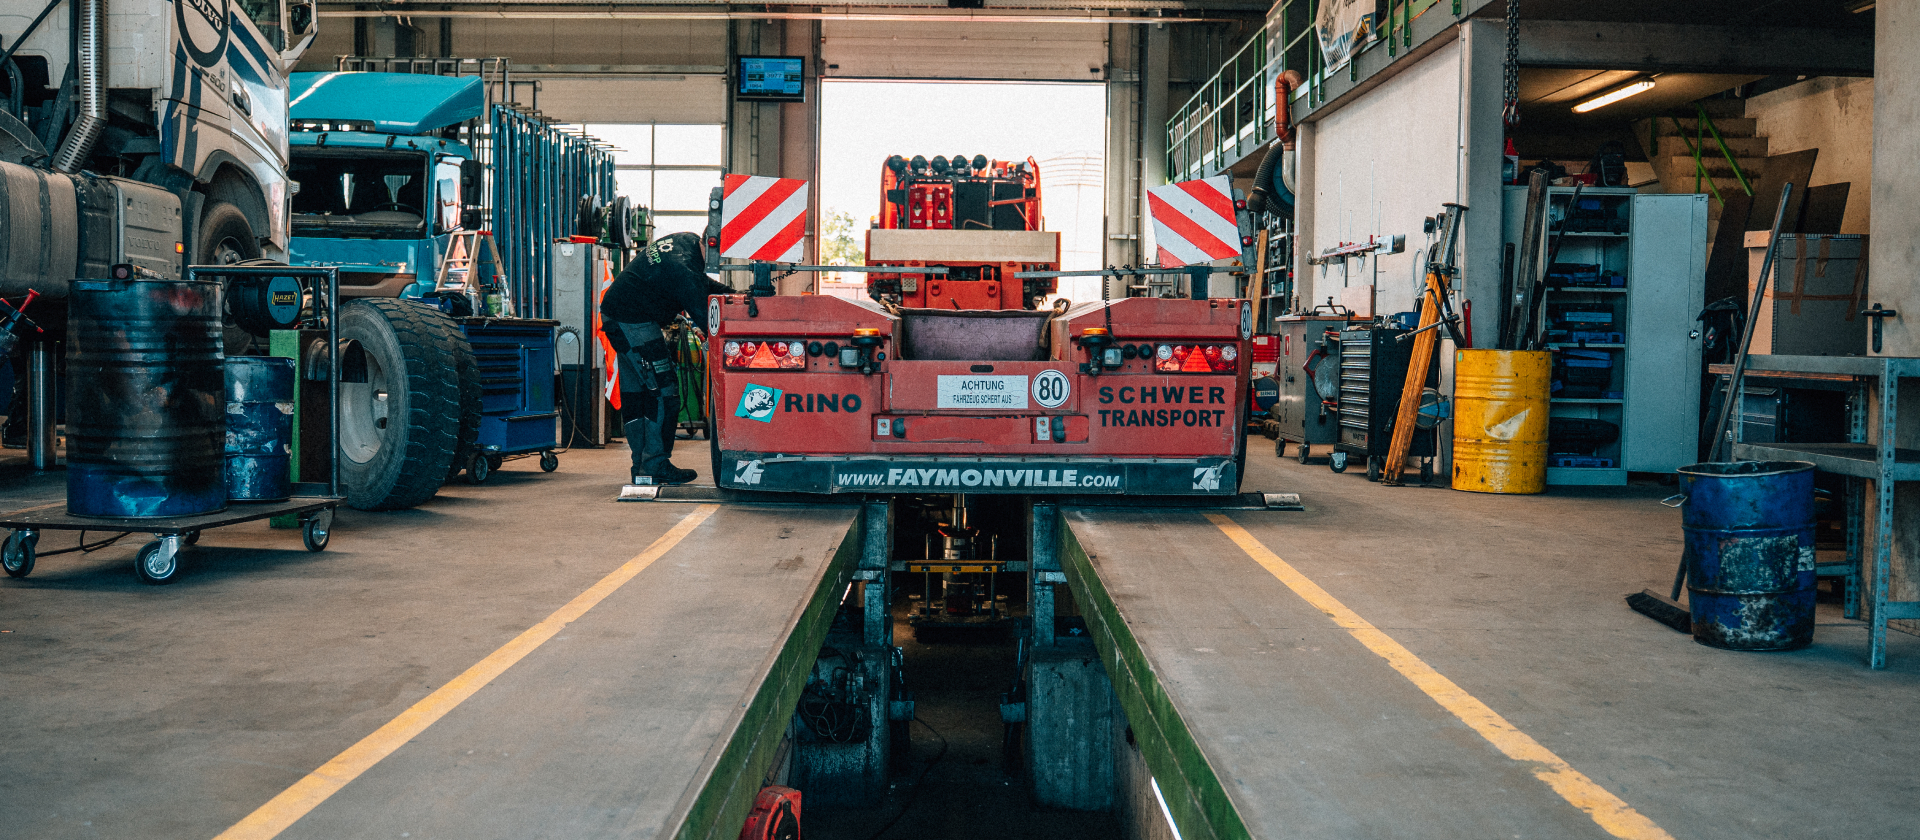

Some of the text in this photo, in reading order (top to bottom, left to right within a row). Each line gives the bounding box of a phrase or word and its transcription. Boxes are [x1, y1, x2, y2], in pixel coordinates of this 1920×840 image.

[209, 73, 225, 92] 500
[273, 293, 295, 303] HAZET
[710, 303, 720, 332] 80
[1242, 309, 1250, 332] 80
[961, 380, 1005, 391] ACHTUNG
[1038, 376, 1063, 401] 80
[784, 393, 862, 413] RINO
[952, 394, 1012, 404] FAHRZEUG SCHERT AUS
[1098, 386, 1226, 404] SCHWER
[1098, 409, 1226, 427] TRANSPORT
